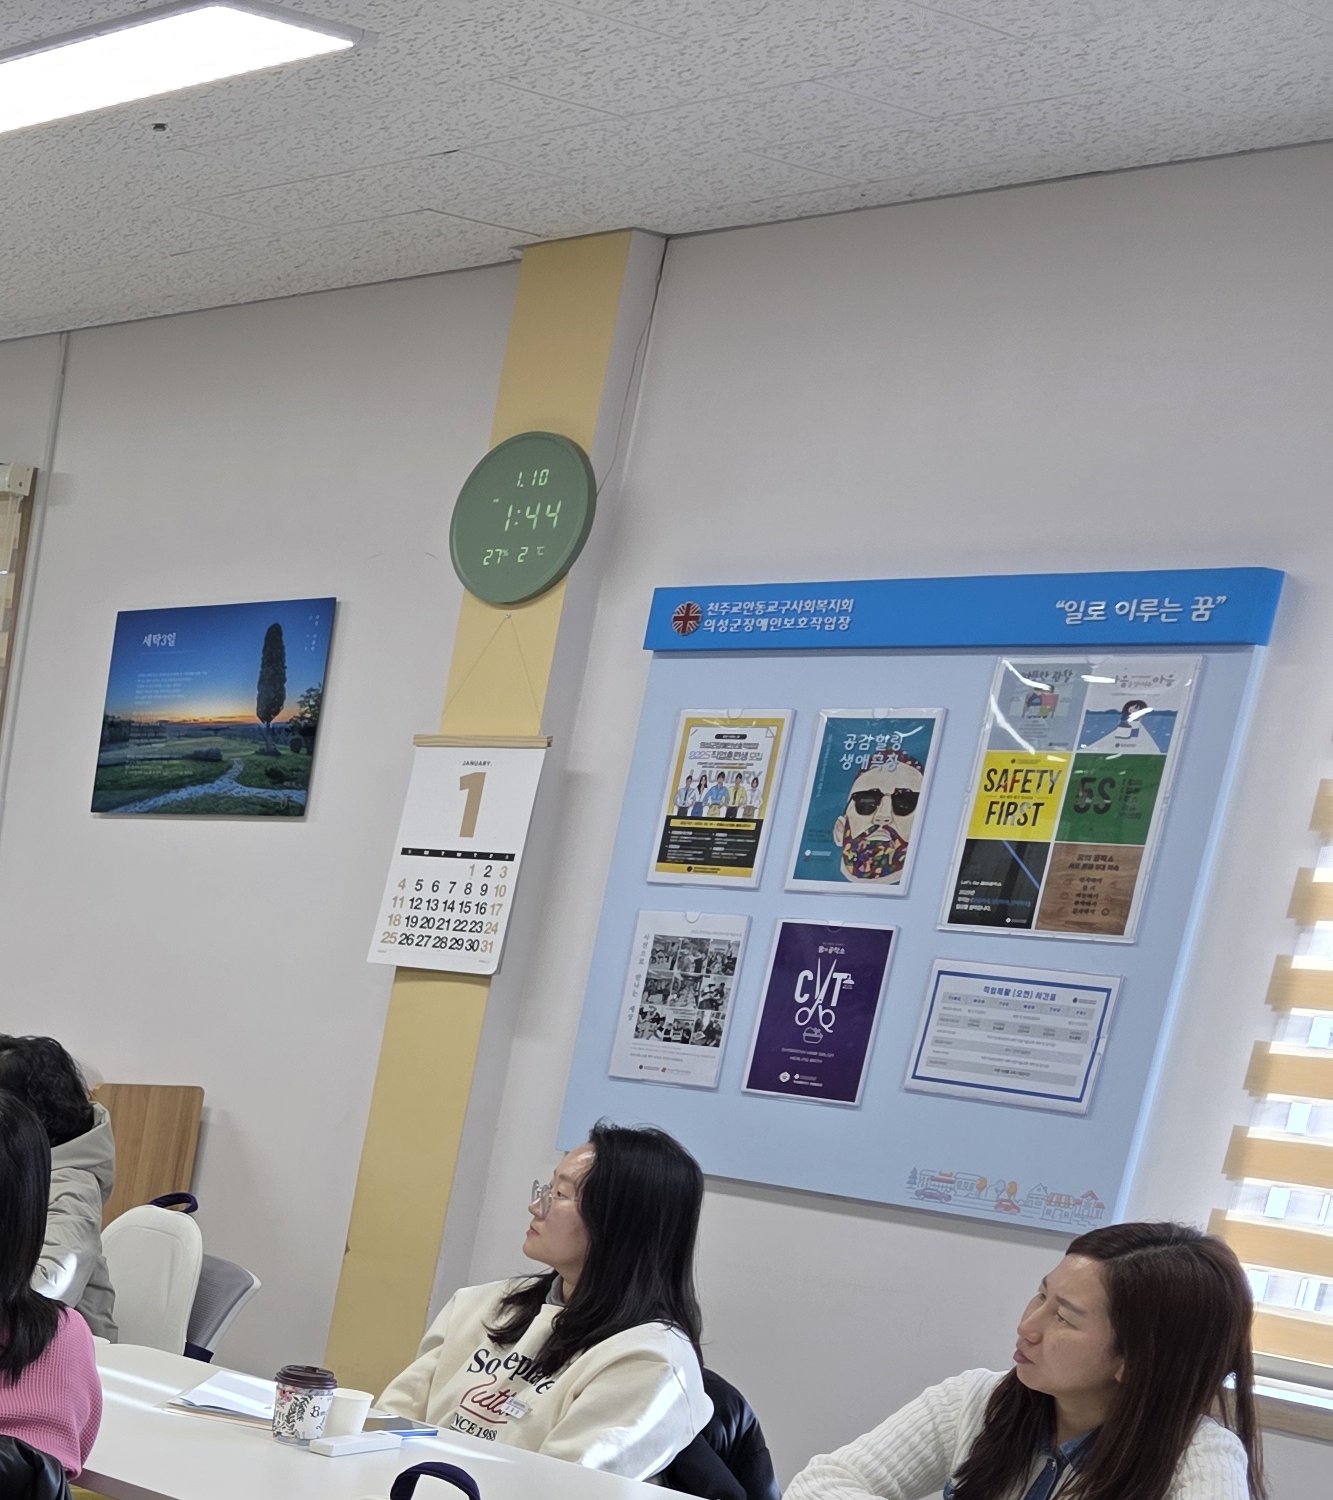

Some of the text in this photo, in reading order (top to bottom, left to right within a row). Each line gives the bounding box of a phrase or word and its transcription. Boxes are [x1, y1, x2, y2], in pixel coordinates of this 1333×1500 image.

[505, 500, 561, 531] 1:44
[707, 599, 854, 616] 천주교안동교구사회복지회
[1115, 598, 1183, 622] 이루는
[703, 616, 851, 632] 의성군장애인보호작업장
[843, 733, 904, 750] 공감힐링
[984, 768, 1062, 794] SAFETY
[459, 772, 486, 838] 1
[985, 801, 1044, 826] FIRST
[469, 864, 508, 879] 1 2 3
[398, 878, 506, 897] 4 5 6 7 8 9 10
[392, 896, 503, 916] 11 12 13 14 15 16 17
[388, 914, 498, 934] 18 19 20 21 22 23 24
[381, 932, 494, 953] 25 26 27 28 29 30 31
